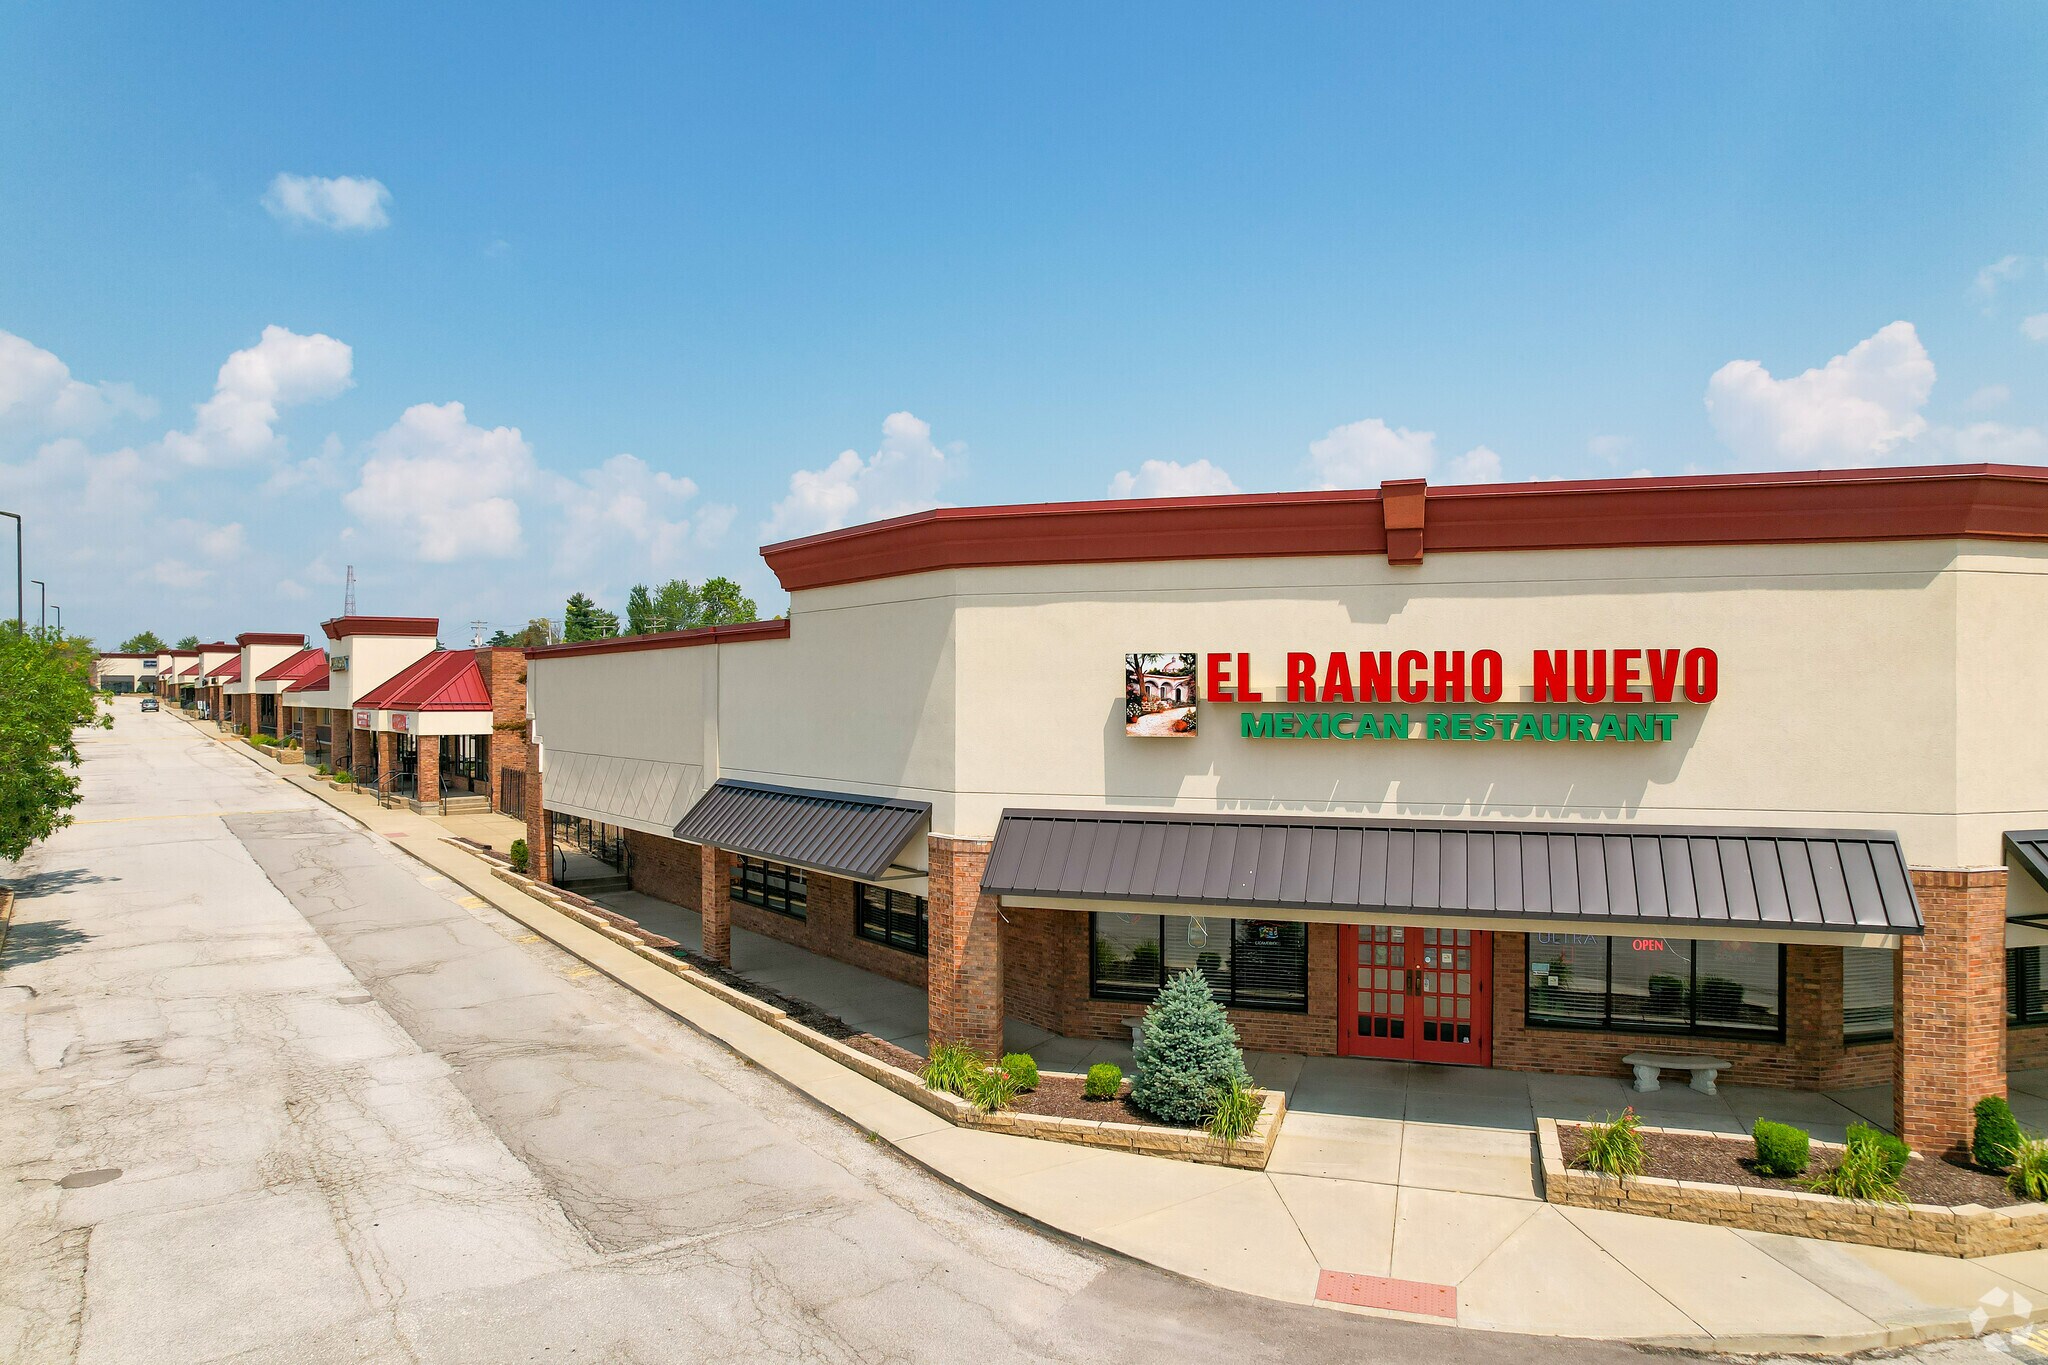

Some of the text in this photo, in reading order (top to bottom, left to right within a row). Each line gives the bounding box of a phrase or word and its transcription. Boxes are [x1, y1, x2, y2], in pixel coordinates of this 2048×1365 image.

[1207, 647, 1719, 704] EL RANCHO NUEVO
[1239, 711, 1680, 743] MEXICAN RESTAURANT
[1632, 939, 1664, 951] OPEN
